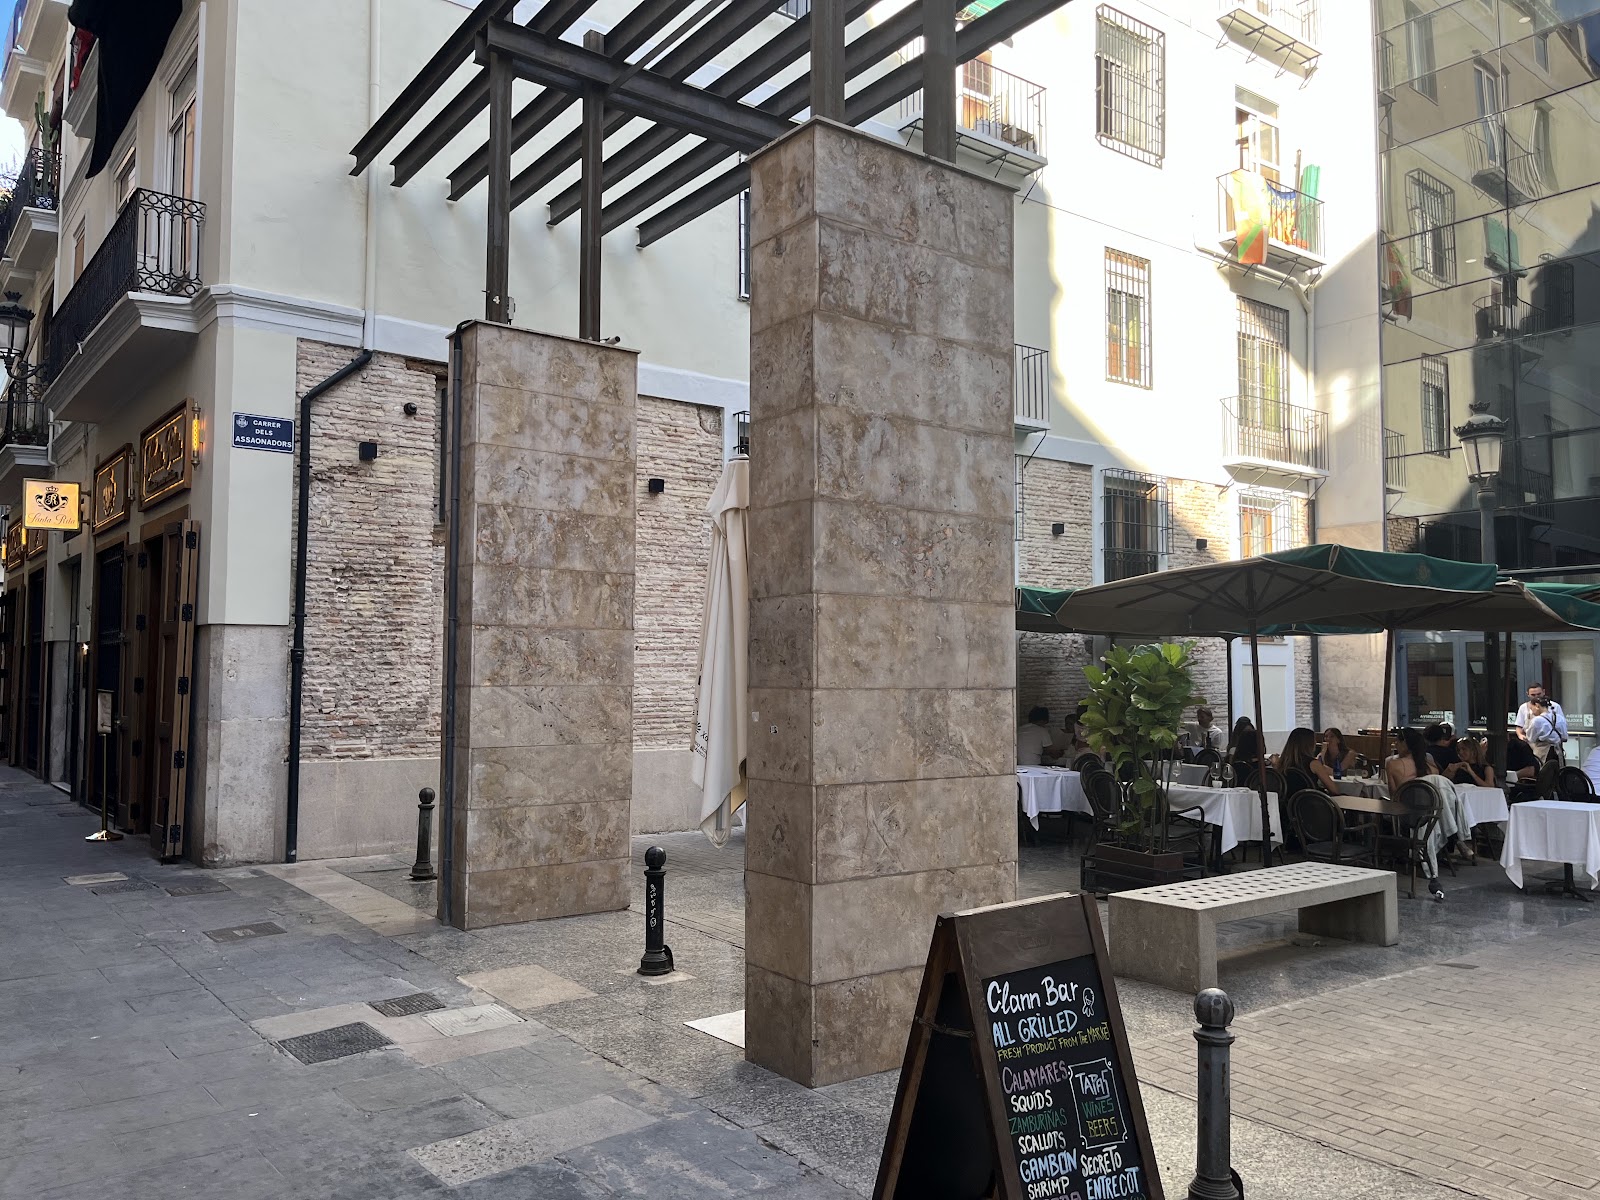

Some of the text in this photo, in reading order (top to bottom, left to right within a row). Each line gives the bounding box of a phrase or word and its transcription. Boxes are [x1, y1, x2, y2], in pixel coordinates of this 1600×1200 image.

[253, 420, 281, 428] CARRER
[235, 436, 292, 448] ASSAONADORS
[28, 513, 76, 525] Santa Rita
[987, 976, 1078, 1014] Clann Bar
[992, 1009, 1078, 1048] ALL GRILLED
[997, 1046, 1023, 1062] FRESH
[1022, 1037, 1058, 1056] PRODUCT
[1058, 1035, 1079, 1050] FROM
[1002, 1060, 1068, 1094] CALAMARES
[1075, 1069, 1110, 1100] TAPAS
[1010, 1089, 1053, 1113] SQUIDS
[1086, 1116, 1119, 1138] BEERS
[1080, 1145, 1122, 1177] SECRETO
[1027, 1176, 1070, 1200] SHRIMP
[1085, 1166, 1141, 1200] ENTRECOT
